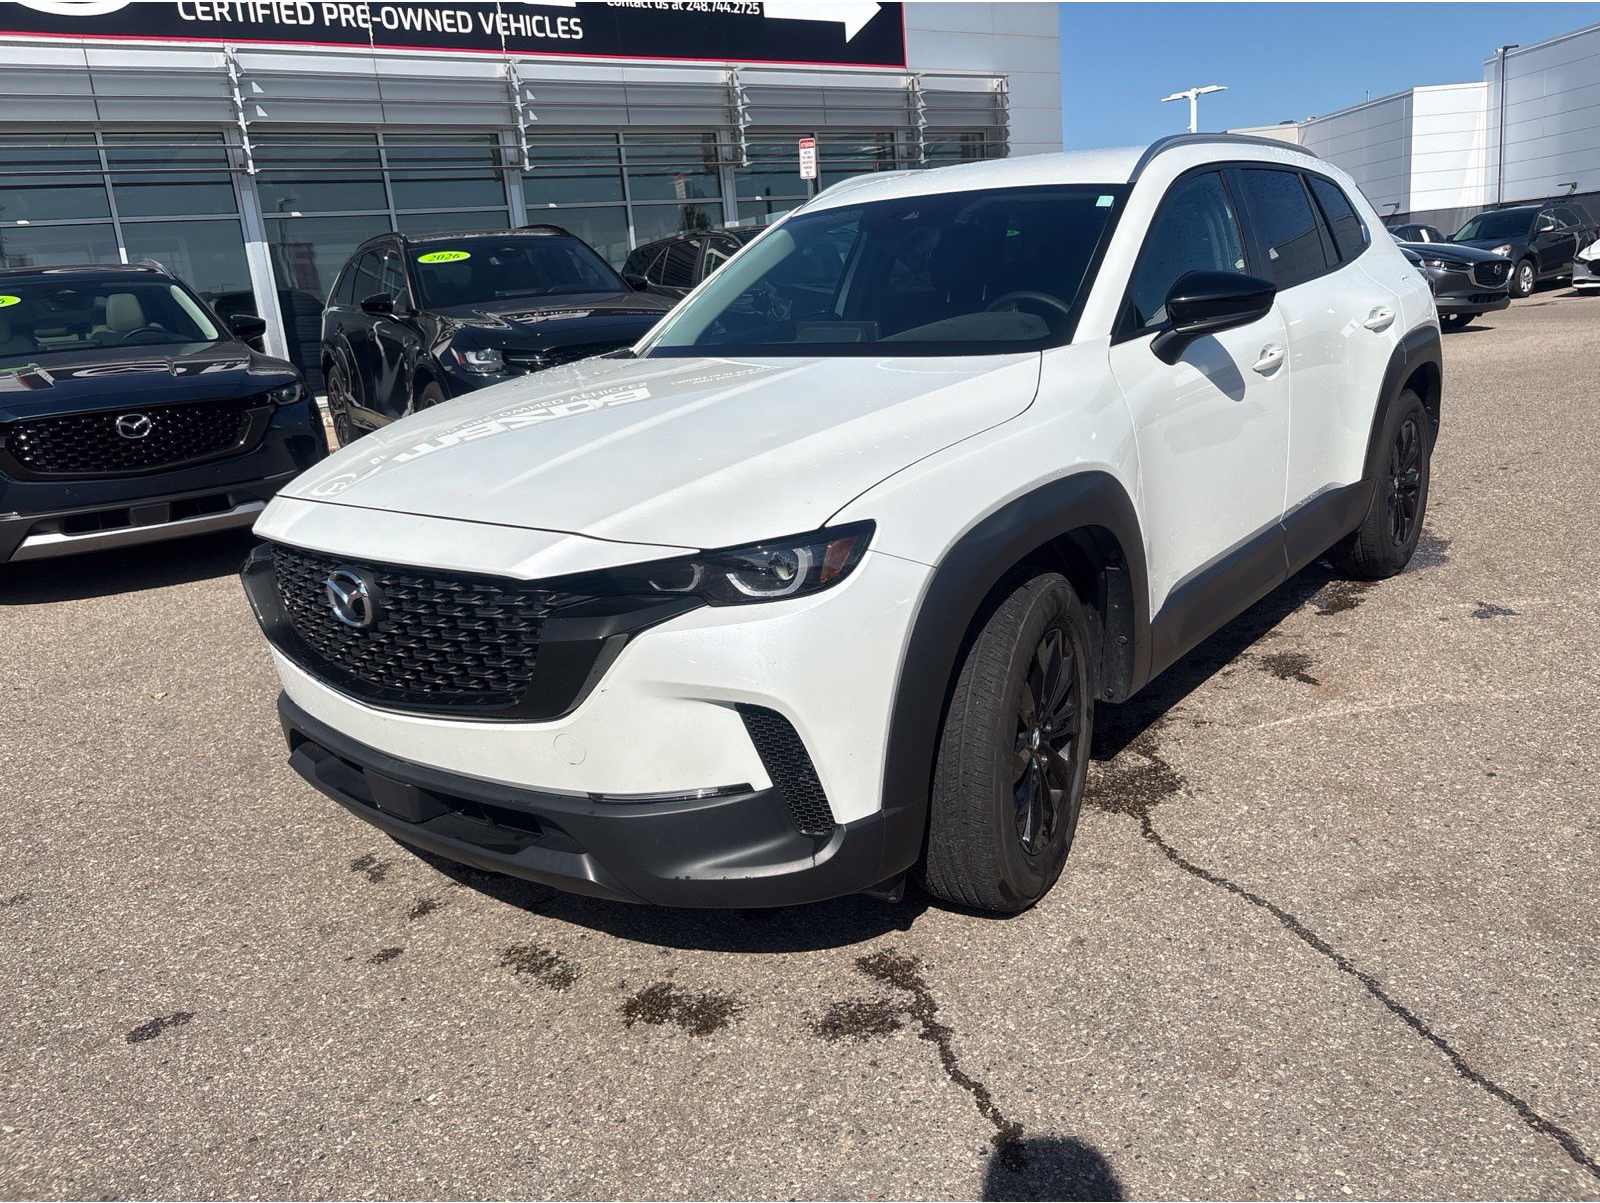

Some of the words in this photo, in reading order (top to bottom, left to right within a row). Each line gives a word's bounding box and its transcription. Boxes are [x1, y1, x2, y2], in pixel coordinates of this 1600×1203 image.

[177, 2, 315, 25] CERTIFIED
[322, 3, 473, 34] PRE-OWNED
[478, 11, 583, 40] VEHICLES
